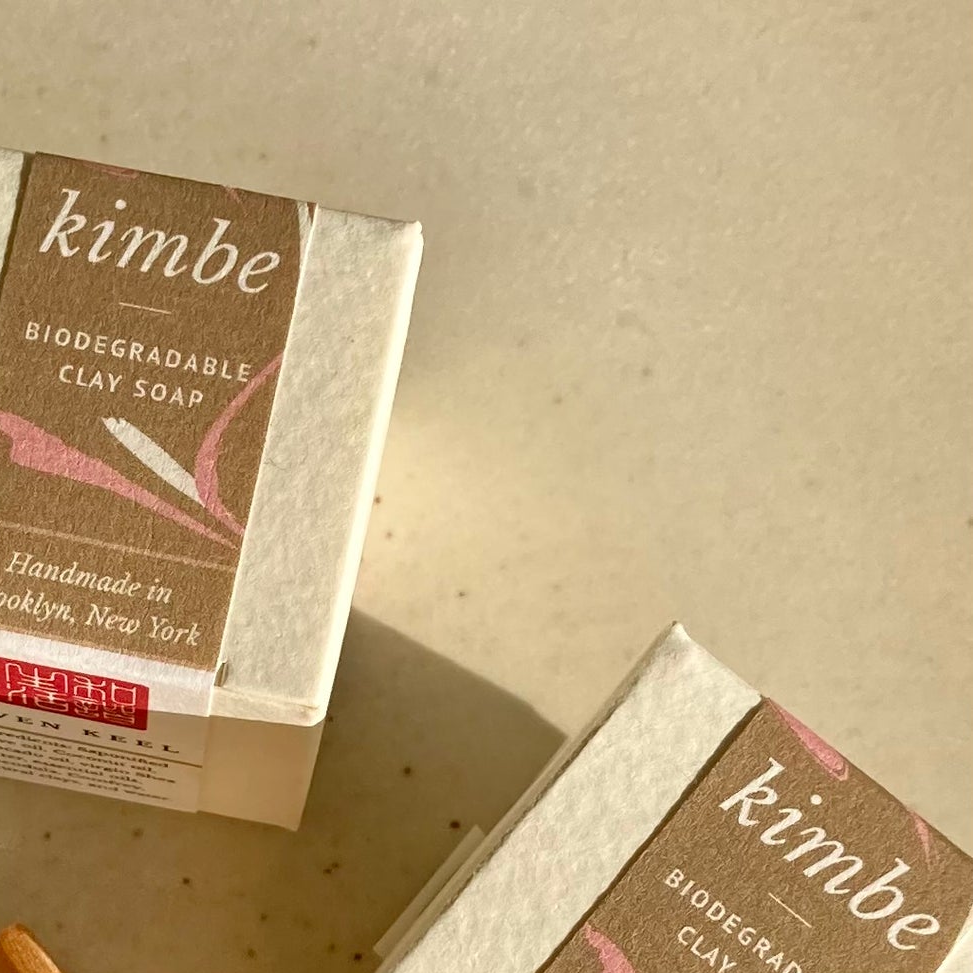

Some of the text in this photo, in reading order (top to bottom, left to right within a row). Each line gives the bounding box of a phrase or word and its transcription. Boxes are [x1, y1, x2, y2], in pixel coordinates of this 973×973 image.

[39, 189, 280, 294] kimbe
[25, 321, 252, 383] BIODEGRADABLE
[58, 365, 205, 409] CLAY SOAP
[5, 551, 174, 604] Handmade in
[85, 604, 142, 635] New
[150, 616, 203, 647] York
[82, 729, 180, 754] KEEL
[719, 757, 941, 951] kimbe
